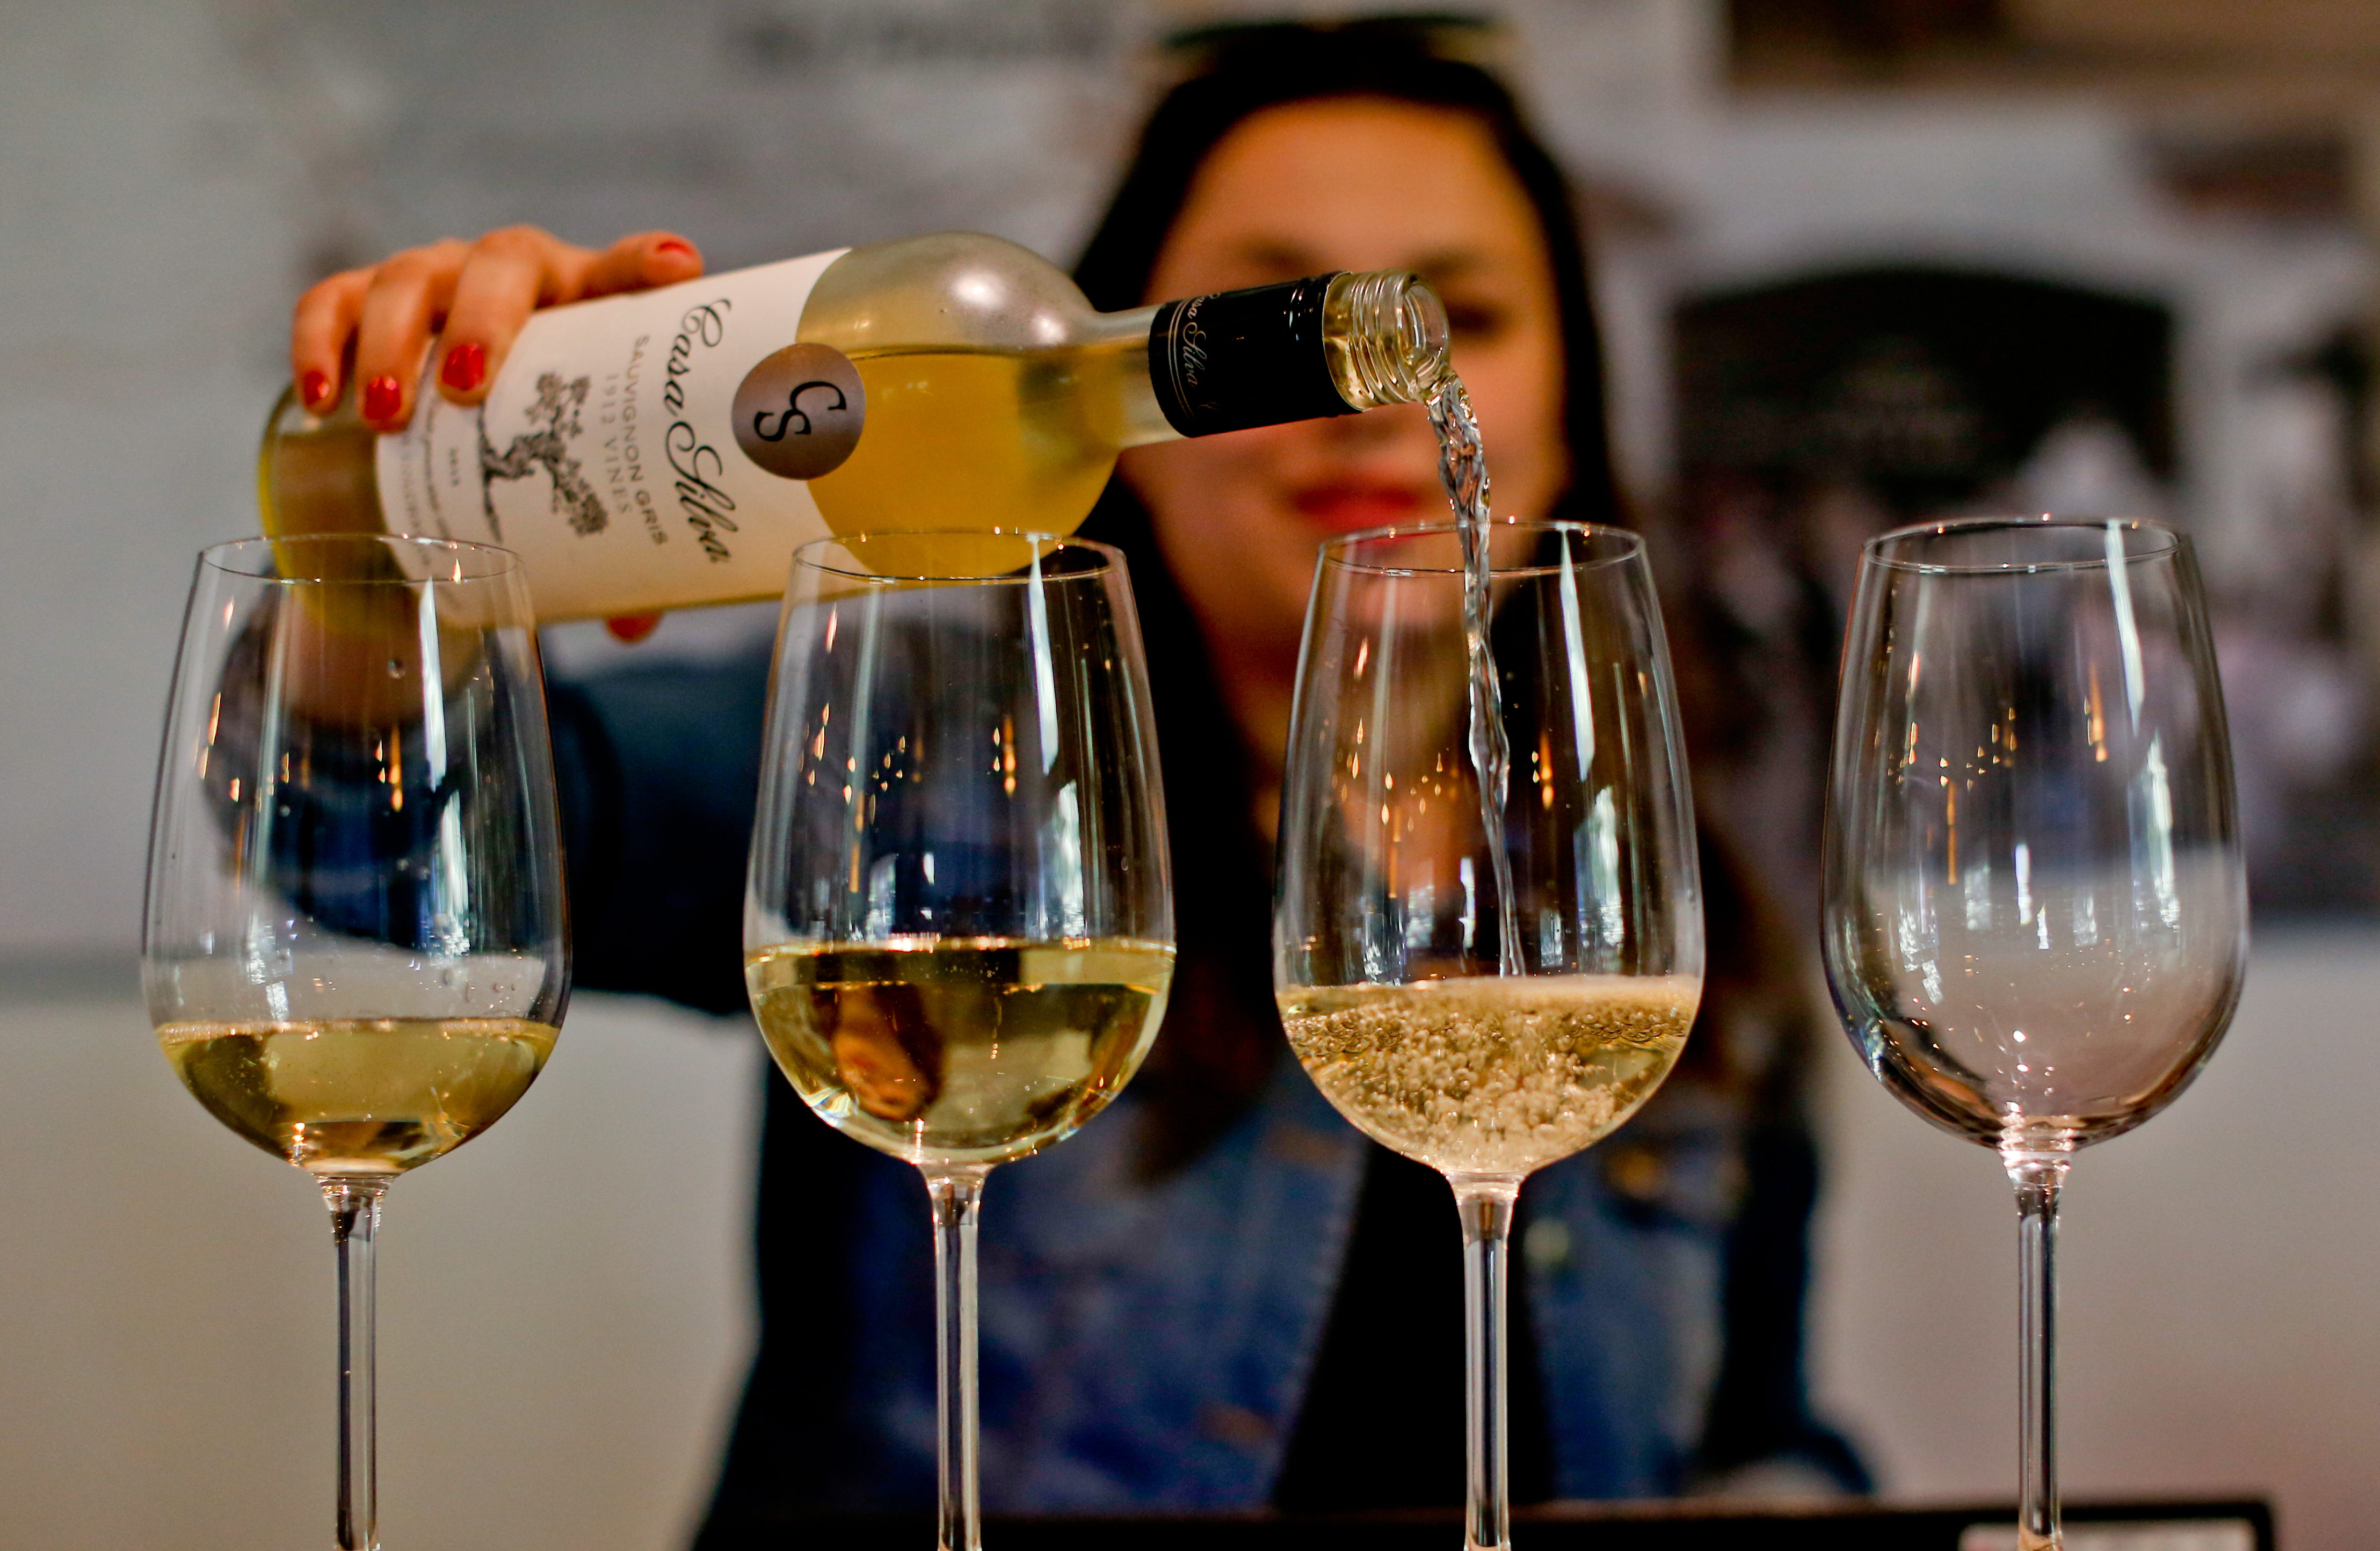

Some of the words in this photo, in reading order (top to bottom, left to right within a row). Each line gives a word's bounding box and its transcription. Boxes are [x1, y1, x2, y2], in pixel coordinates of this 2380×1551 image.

[664, 298, 731, 417] Casa
[1182, 322, 1207, 388] Silva
[601, 374, 618, 426] 1912
[622, 335, 650, 482] SAUVIGNON
[754, 380, 847, 442] CS
[604, 436, 632, 514] VINES
[665, 420, 738, 564] Silva
[635, 489, 668, 546] GRIS
